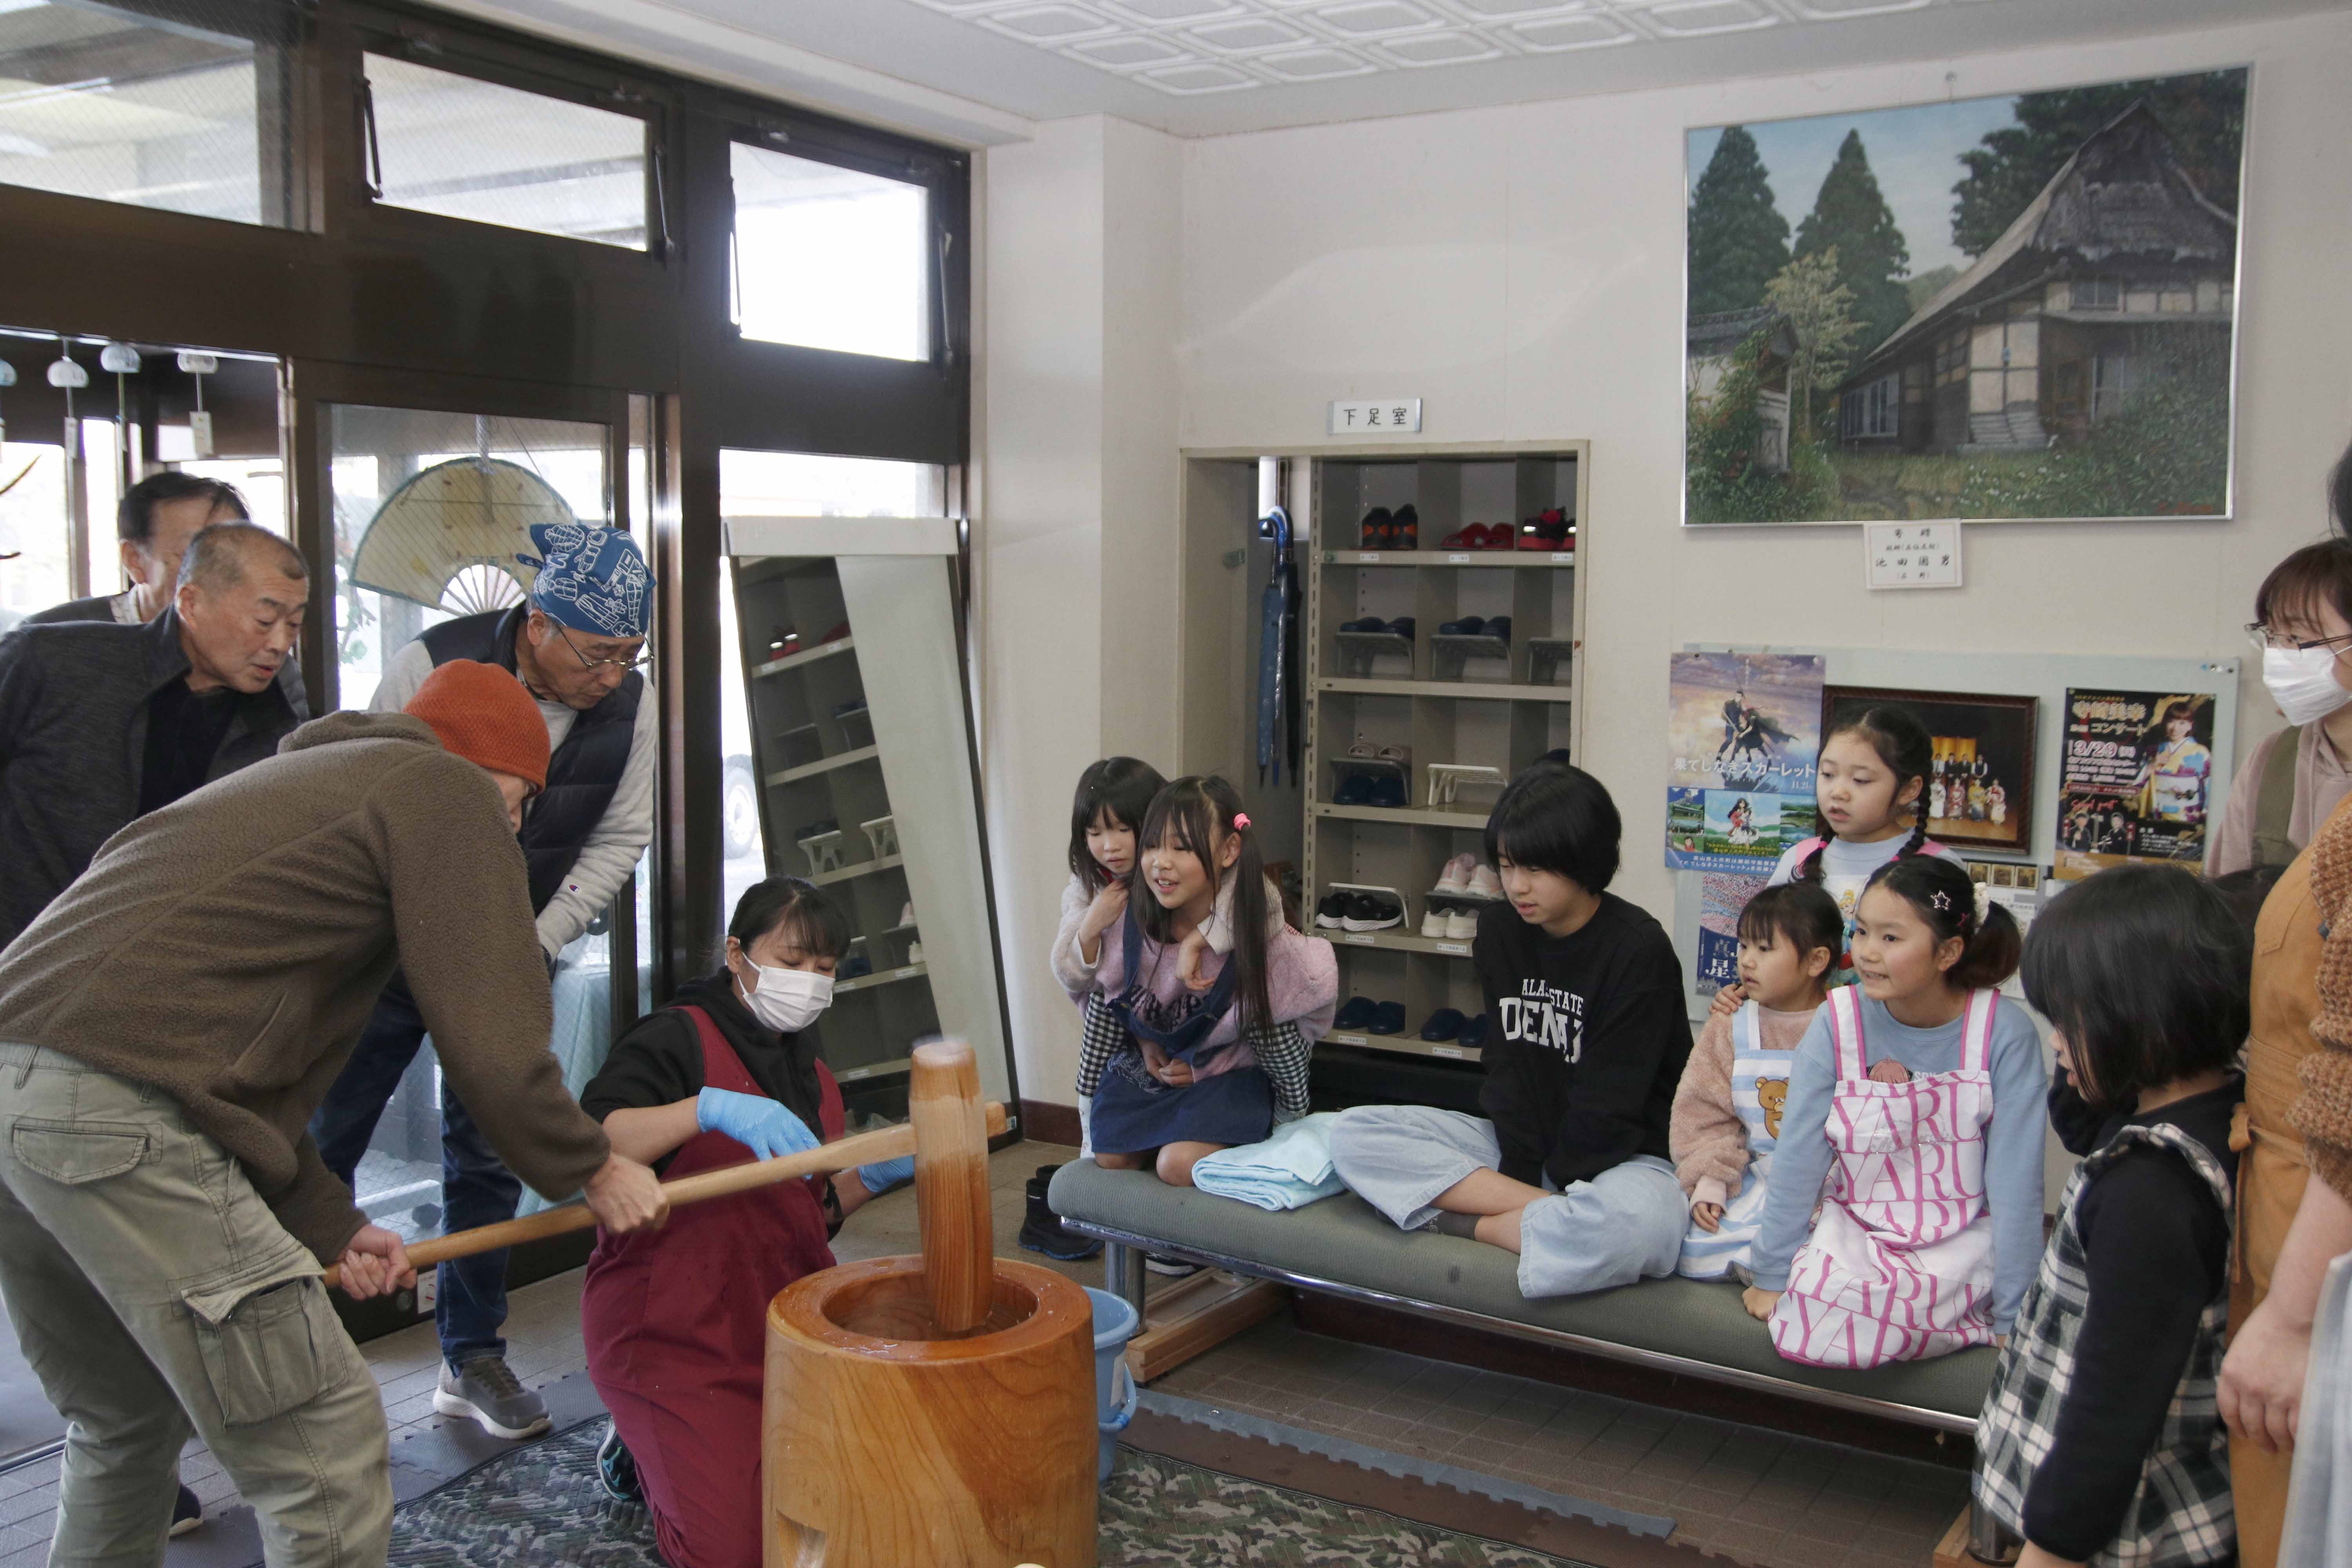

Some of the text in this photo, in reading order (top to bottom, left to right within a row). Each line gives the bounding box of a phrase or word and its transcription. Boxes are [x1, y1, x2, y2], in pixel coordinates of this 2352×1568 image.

[1343, 407, 1407, 426] 下足室
[2090, 722, 2150, 737] コンサート
[1674, 757, 1816, 779] 果てしなきスカーレット
[1549, 988, 1584, 1016] STATE
